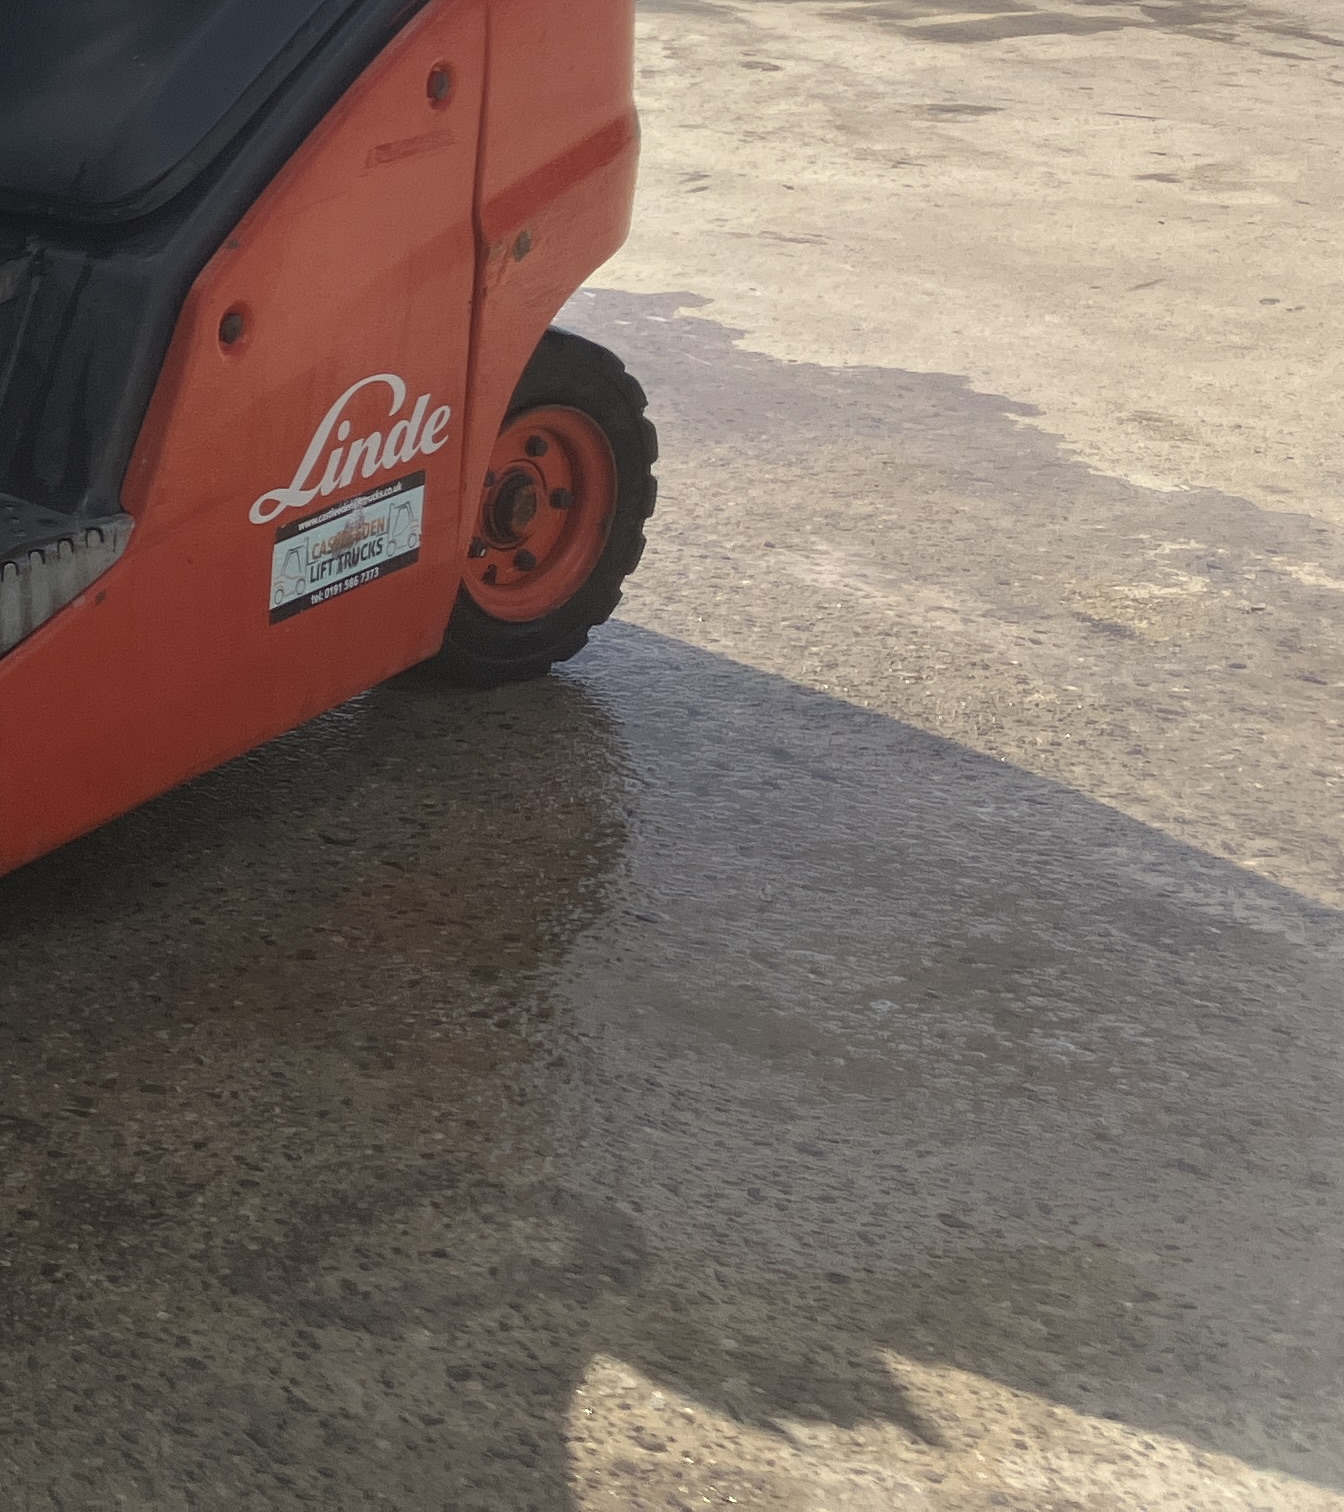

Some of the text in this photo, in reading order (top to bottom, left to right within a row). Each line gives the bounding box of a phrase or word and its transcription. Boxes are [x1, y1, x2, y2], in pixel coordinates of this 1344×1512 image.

[249, 373, 451, 524] Linde
[310, 538, 384, 583] LIFT TRUCKS
[324, 583, 343, 600] 0191
[361, 567, 380, 586] 7373
